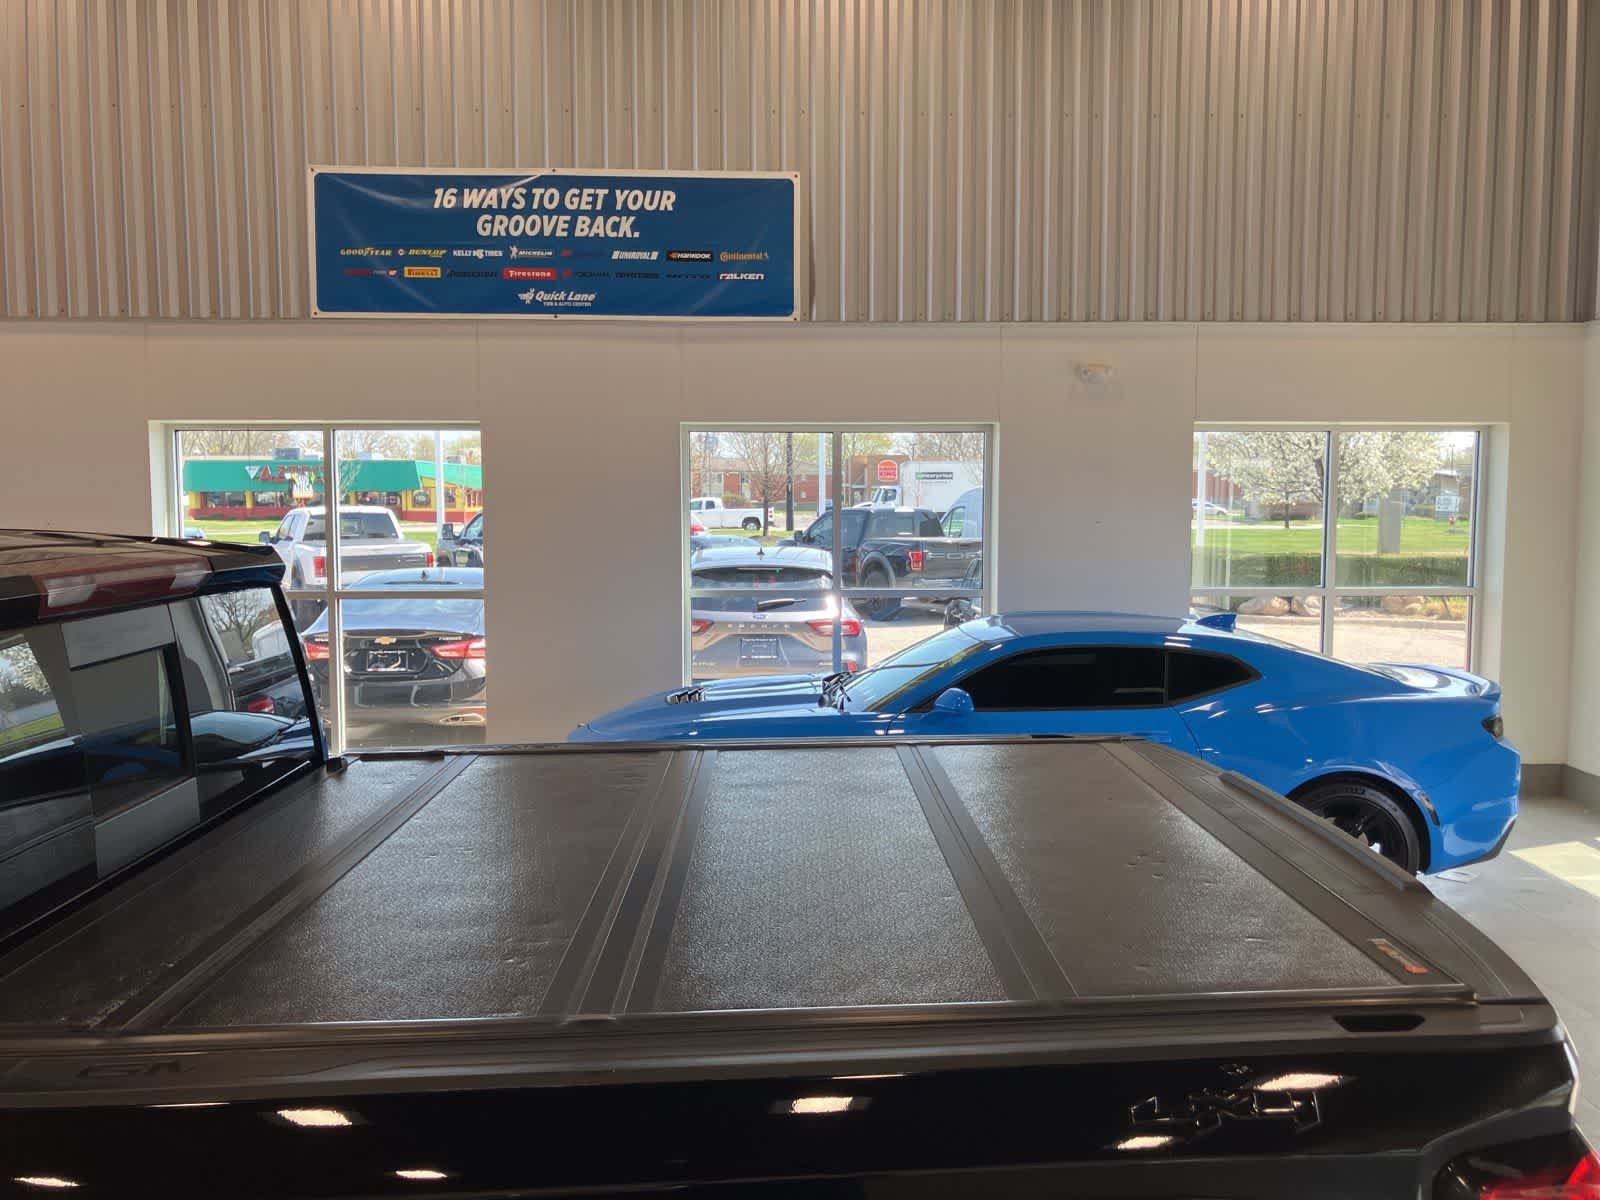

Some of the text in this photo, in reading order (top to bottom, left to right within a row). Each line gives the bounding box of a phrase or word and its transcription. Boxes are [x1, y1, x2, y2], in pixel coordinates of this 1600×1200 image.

[433, 187, 676, 211] 16 WAYS TO GET YOUR
[476, 214, 640, 238] GROOVE BACK.
[340, 247, 393, 257] GOODYEAR
[408, 249, 447, 258] DUNLOP
[509, 270, 552, 278] Firestone
[535, 291, 596, 302] Quick Lane
